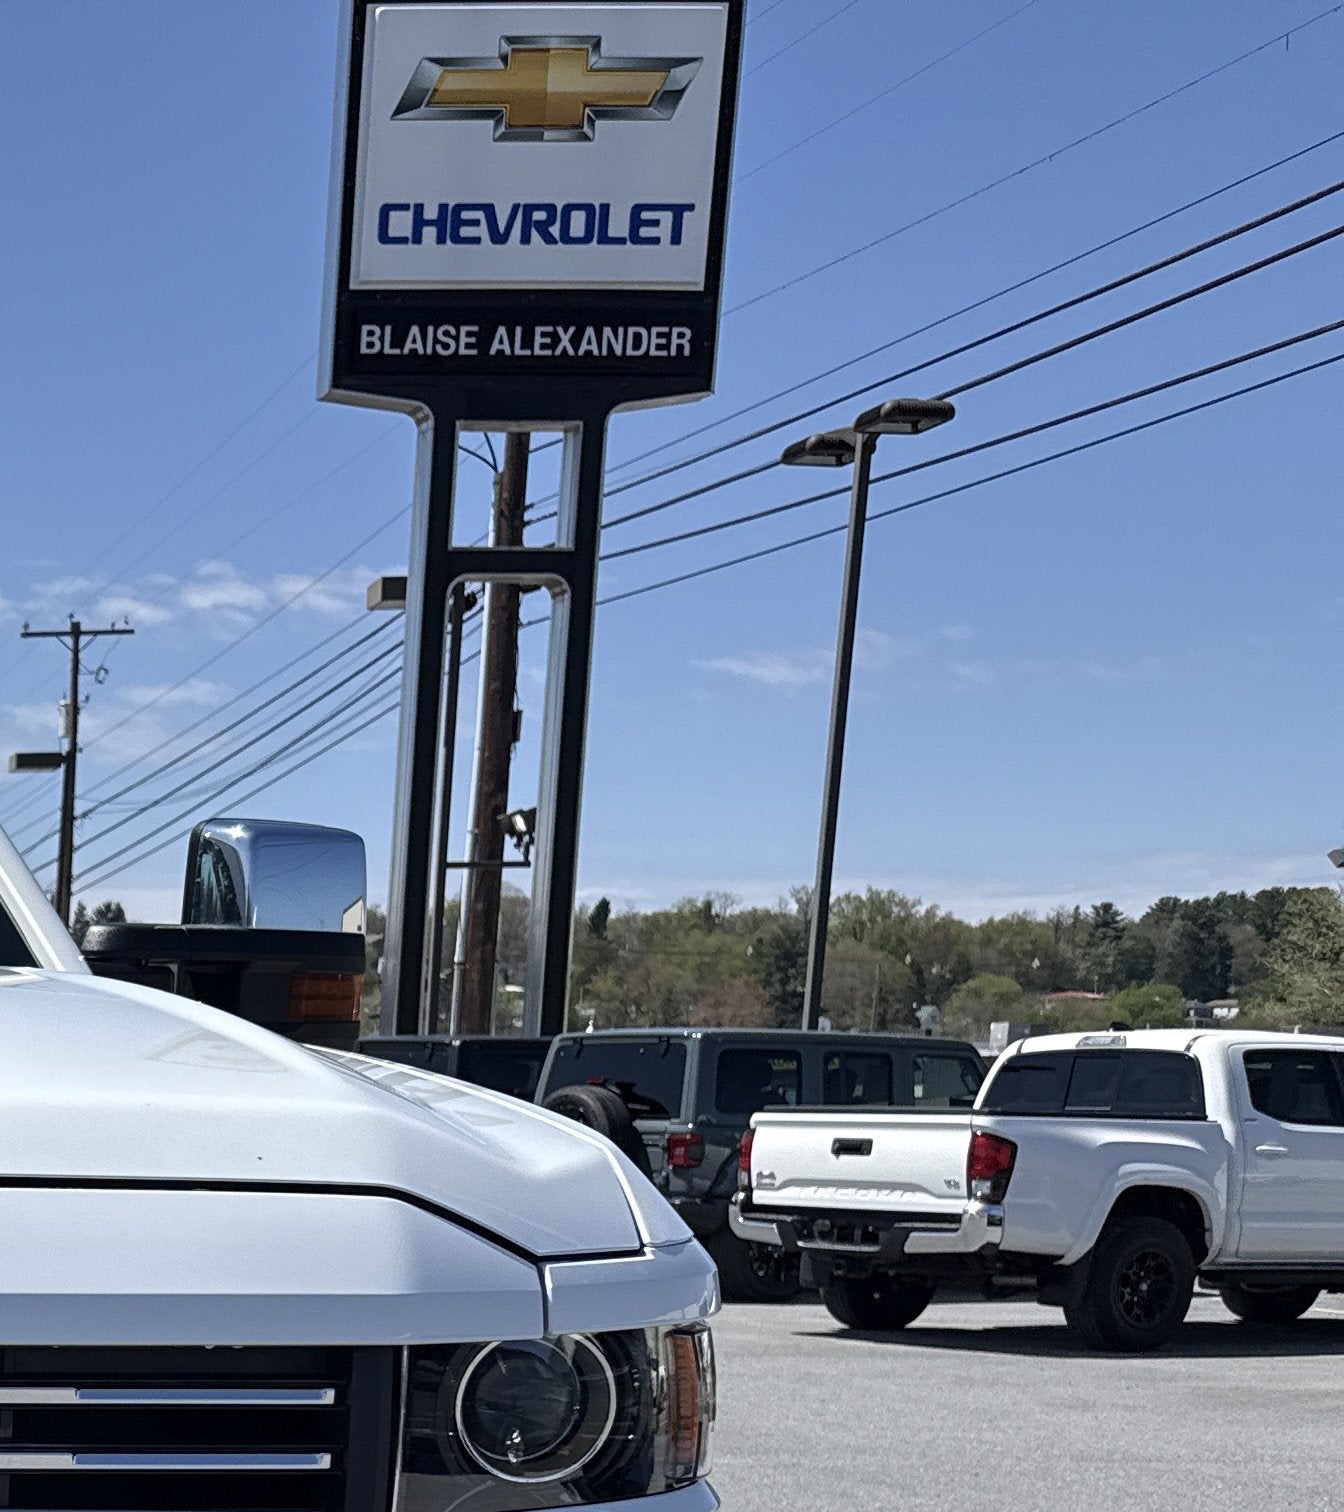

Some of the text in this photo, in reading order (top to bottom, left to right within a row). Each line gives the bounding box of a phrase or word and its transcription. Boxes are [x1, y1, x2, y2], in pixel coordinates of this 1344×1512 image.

[377, 202, 695, 246] CHEVROLET
[360, 324, 692, 357] BLAISE ALEXANDER
